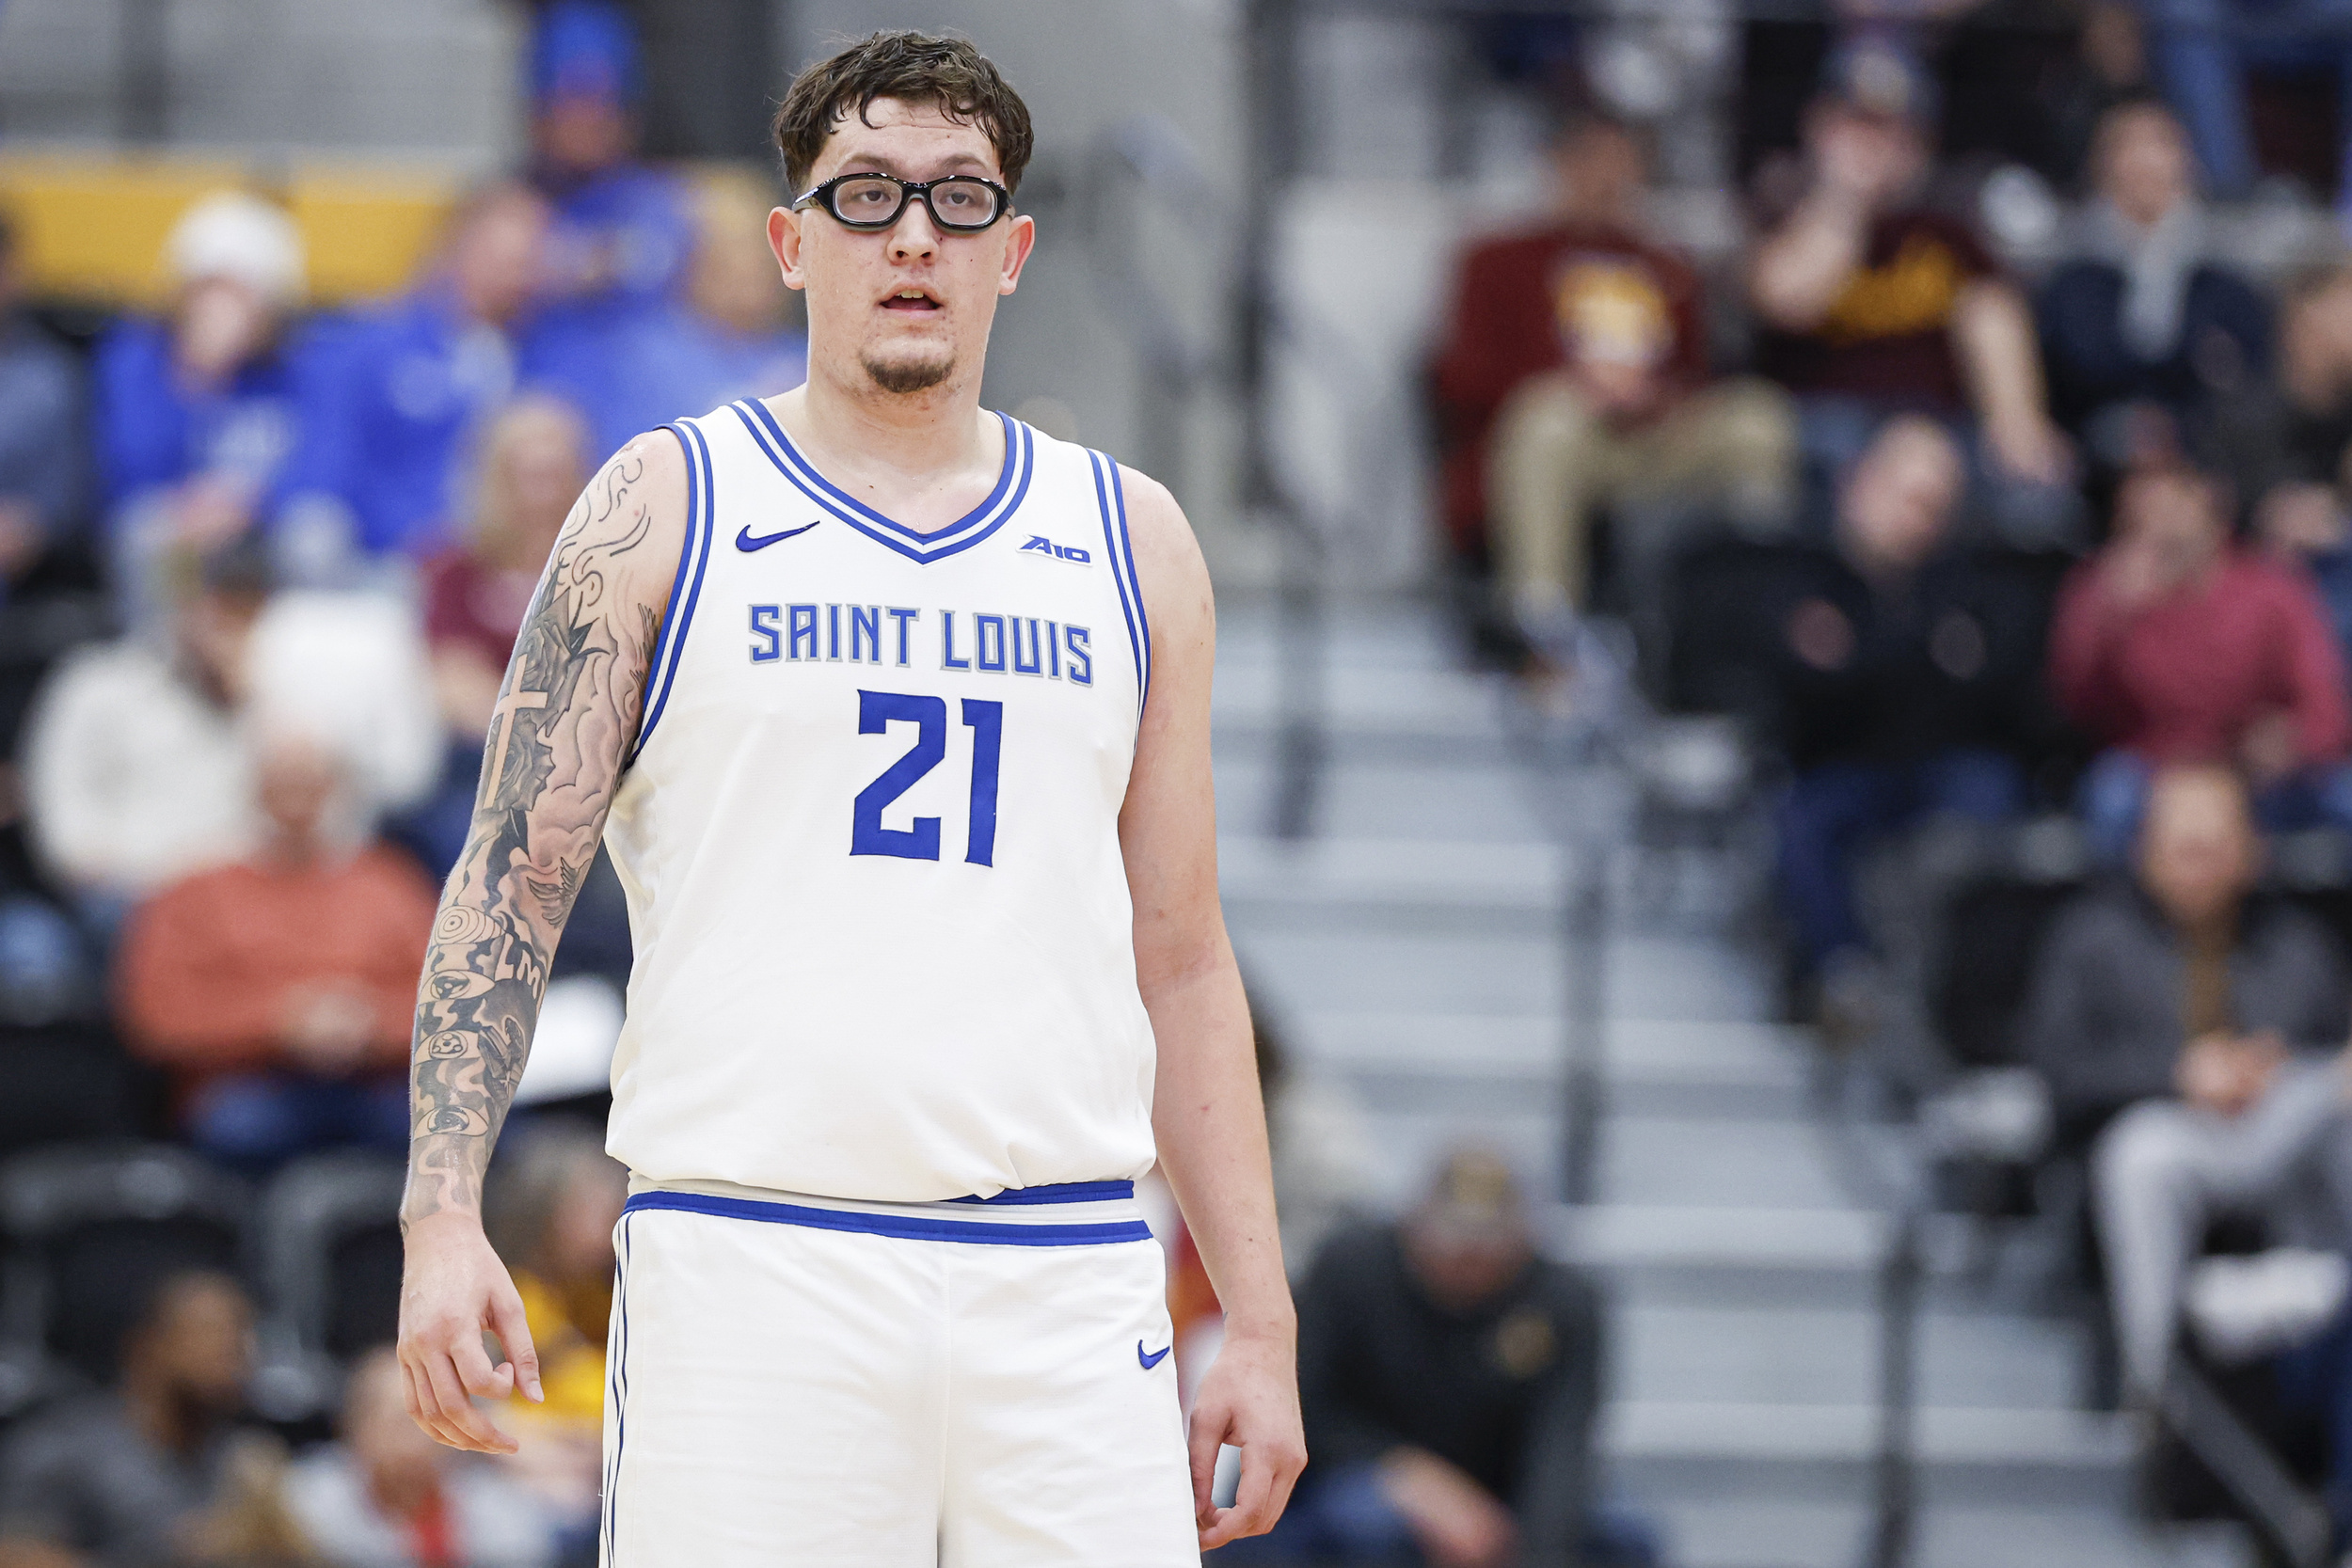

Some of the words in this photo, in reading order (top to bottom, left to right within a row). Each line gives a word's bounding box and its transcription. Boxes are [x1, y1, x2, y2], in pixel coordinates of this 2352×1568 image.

[1019, 534, 1091, 564] A10
[748, 603, 920, 669] SAINT
[940, 610, 1094, 688] LOUIS
[850, 689, 1003, 867] 21
